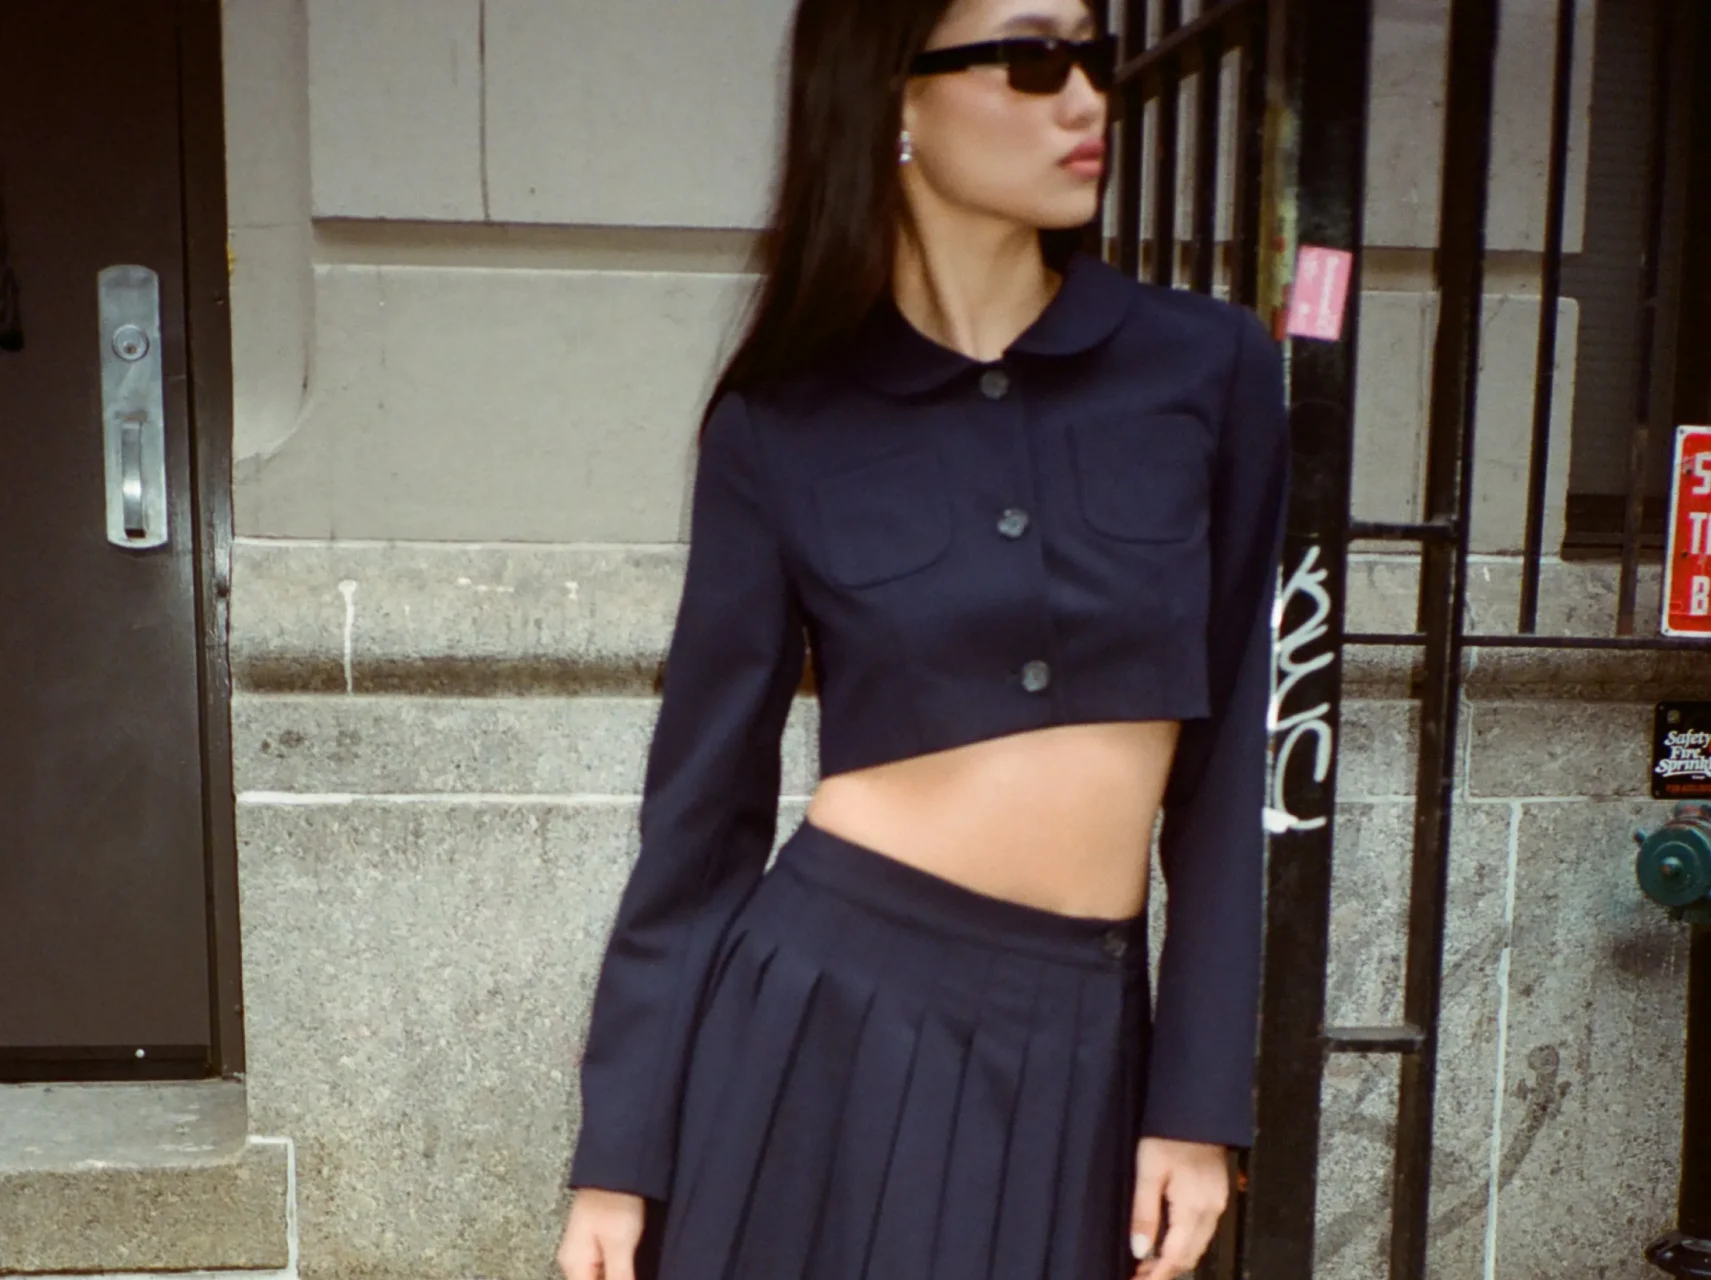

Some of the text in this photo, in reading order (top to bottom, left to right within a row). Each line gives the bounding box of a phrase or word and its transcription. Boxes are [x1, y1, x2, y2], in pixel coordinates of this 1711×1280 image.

[1688, 512, 1711, 554] T
[1664, 728, 1711, 748] Safety
[1669, 746, 1701, 760] Fire
